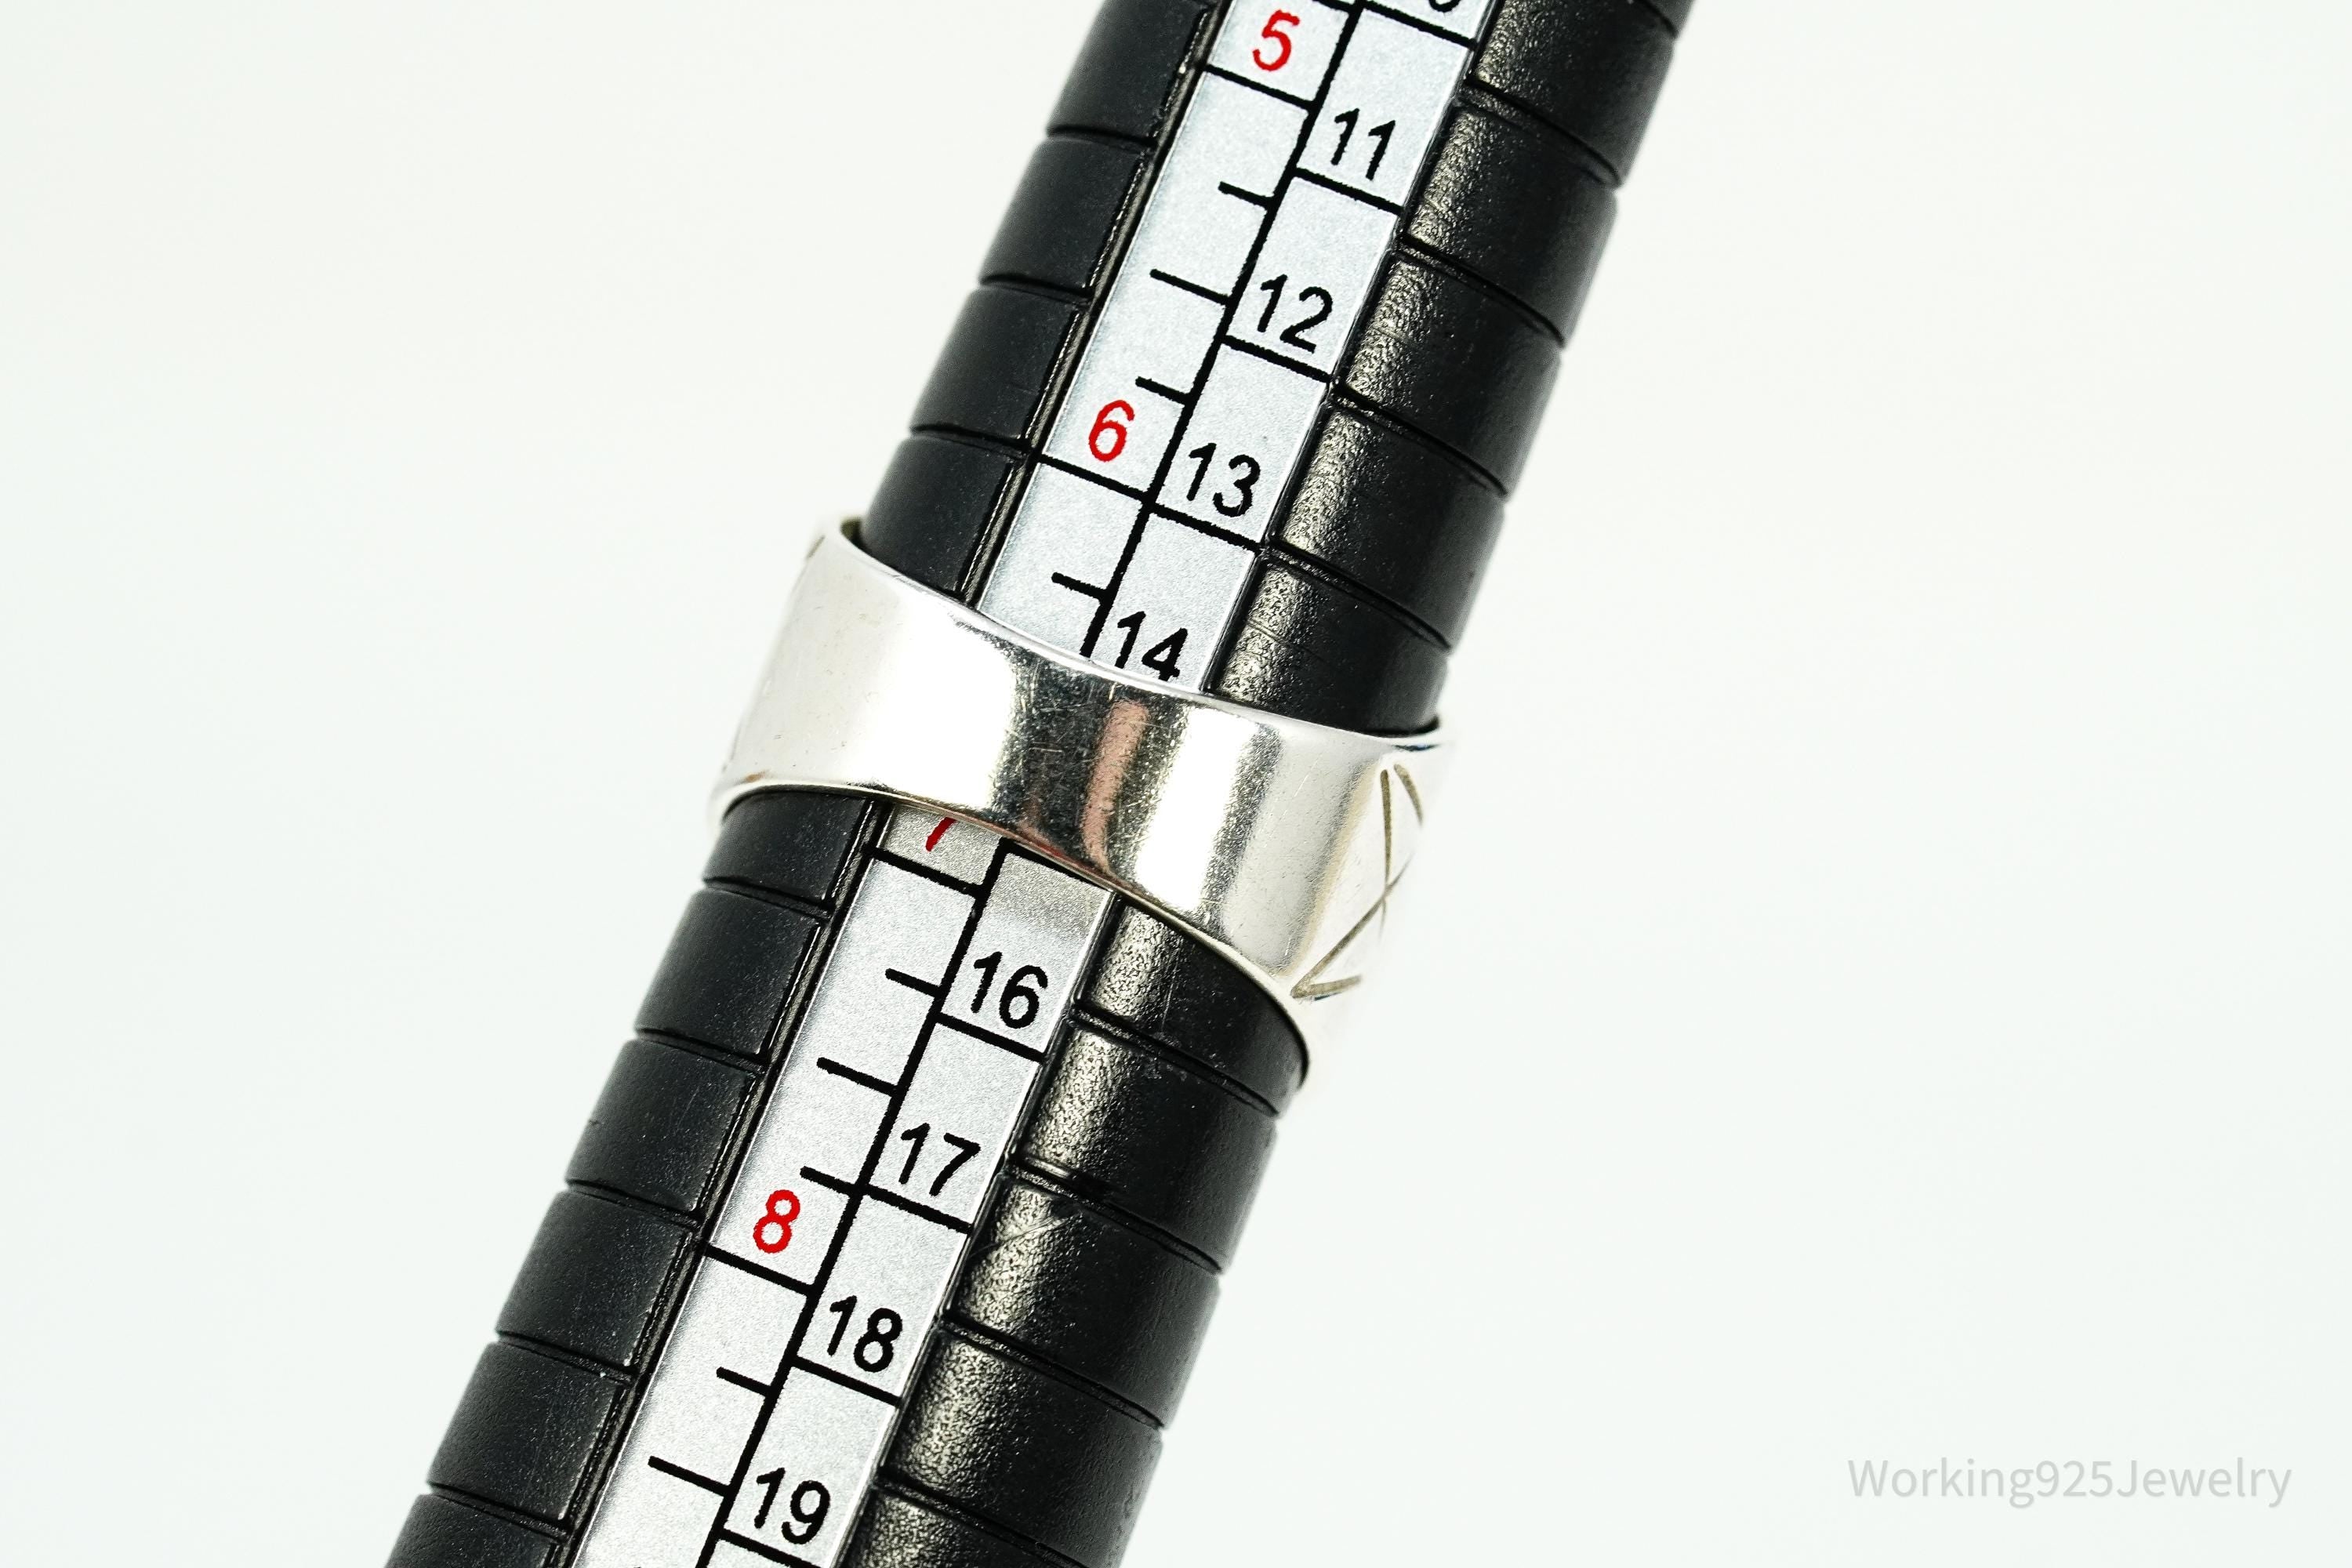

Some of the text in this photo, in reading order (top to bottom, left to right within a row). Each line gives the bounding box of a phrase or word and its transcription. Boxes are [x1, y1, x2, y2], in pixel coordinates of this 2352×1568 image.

[1252, 9, 1300, 71] 5
[1331, 107, 1396, 180] 11
[1258, 274, 1333, 354] 12
[1088, 399, 1134, 462] 6
[1185, 442, 1261, 517] 13
[1116, 612, 1187, 681] 14
[974, 951, 1048, 1029] 16
[900, 1123, 982, 1196] 17
[753, 1189, 800, 1254] 8
[828, 1295, 902, 1373] 18
[754, 1468, 830, 1544] 19
